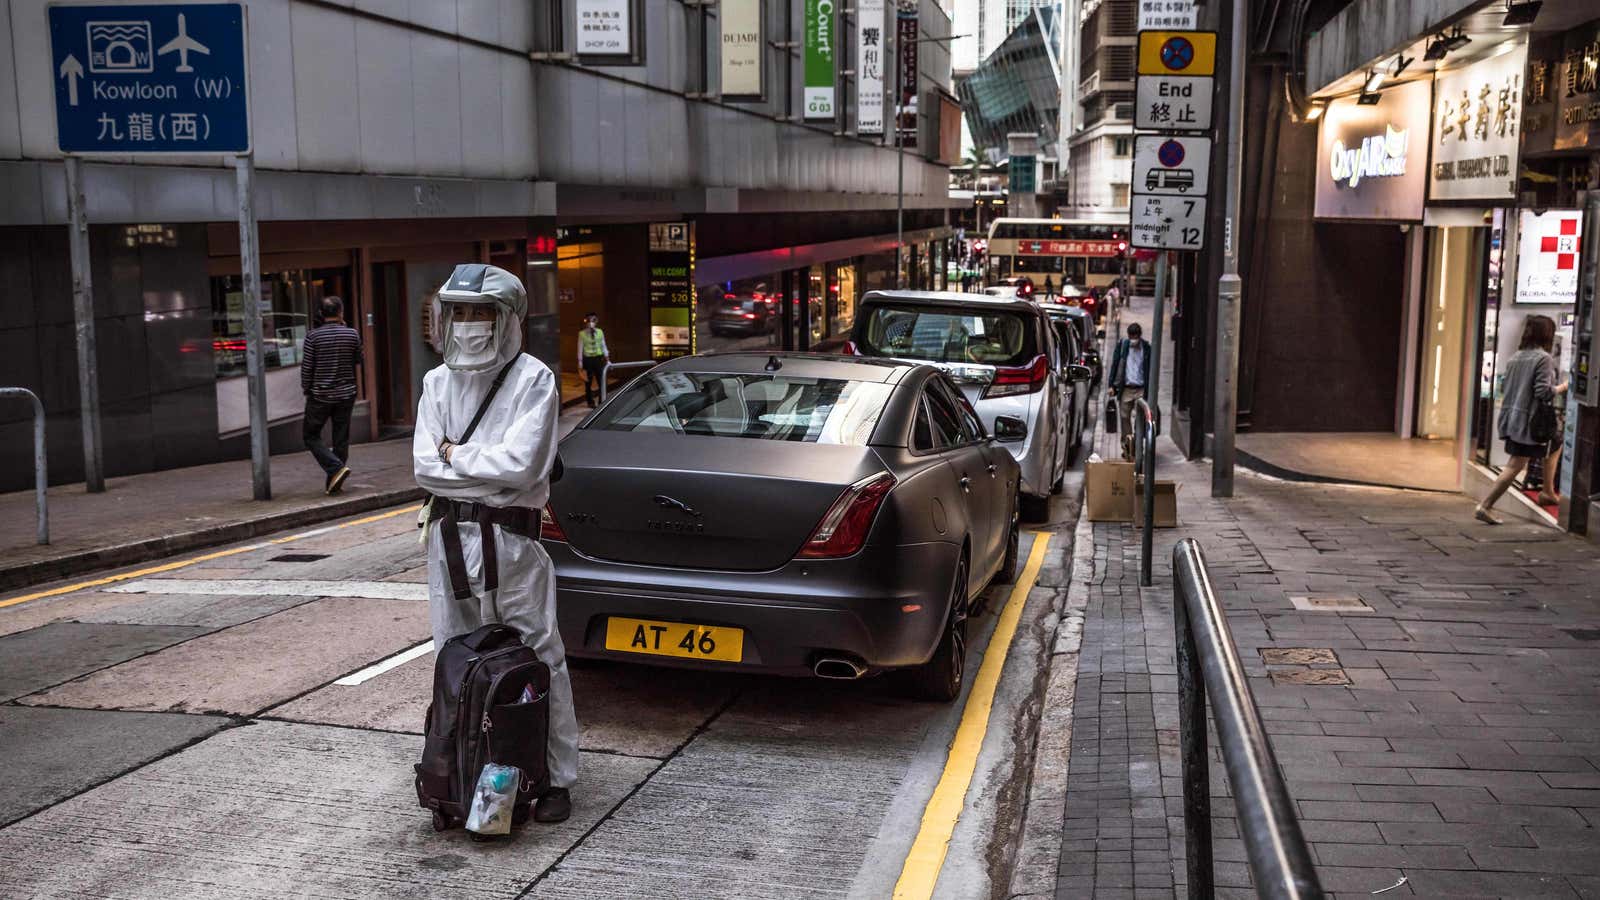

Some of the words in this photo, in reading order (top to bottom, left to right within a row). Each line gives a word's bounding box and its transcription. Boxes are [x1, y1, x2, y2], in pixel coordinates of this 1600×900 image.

[93, 80, 177, 100] Kowloon
[194, 77, 232, 99] (W)
[1159, 82, 1192, 97] End
[809, 103, 817, 112] G
[819, 104, 831, 112] 03
[1150, 103, 1196, 123] 終止
[97, 112, 211, 141] 九龍(西)
[1143, 207, 1162, 216] 上午
[1183, 201, 1195, 218] 7
[1134, 223, 1170, 233] midnight
[1181, 227, 1200, 245] 12
[632, 625, 667, 649] AT
[679, 629, 715, 654] 46
